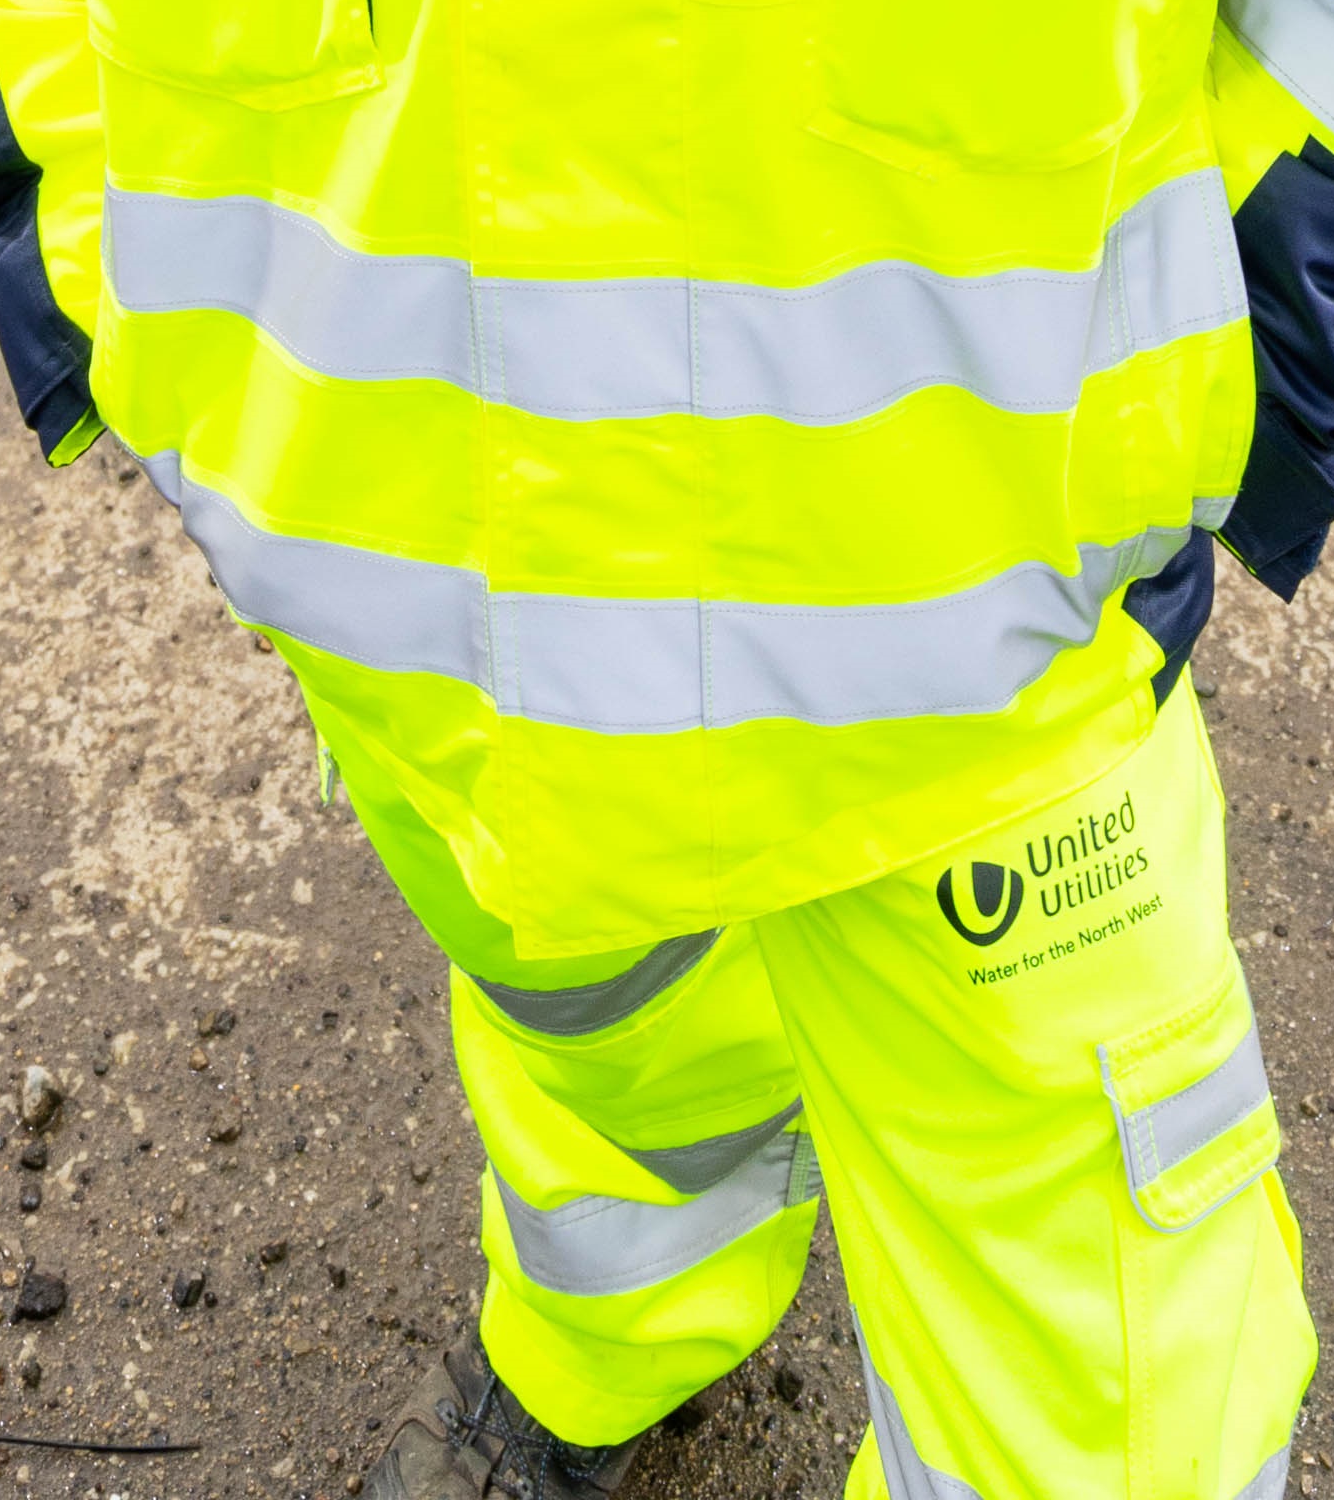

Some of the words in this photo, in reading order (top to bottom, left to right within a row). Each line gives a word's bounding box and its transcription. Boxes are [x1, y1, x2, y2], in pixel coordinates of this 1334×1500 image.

[1026, 791, 1135, 877] United
[1040, 847, 1149, 917] Utilities
[967, 961, 1018, 986] Water
[1022, 952, 1045, 971] for
[1049, 939, 1076, 960] the
[1078, 916, 1125, 948] North
[1125, 892, 1164, 926] West
